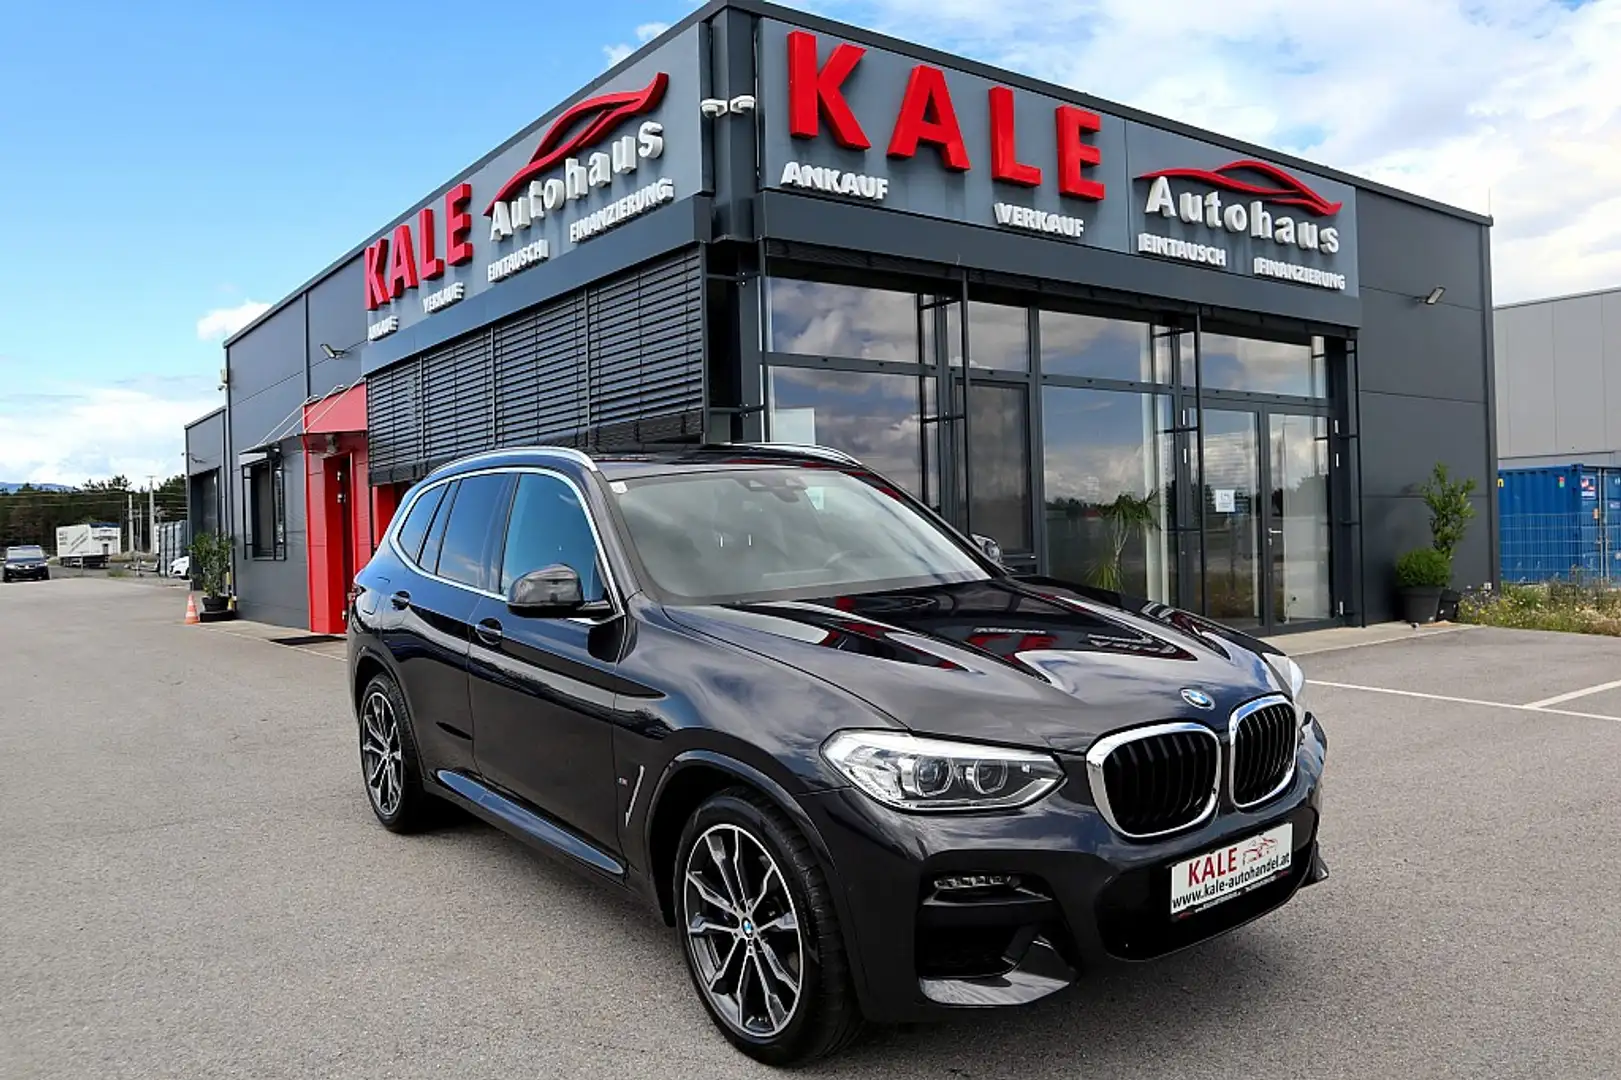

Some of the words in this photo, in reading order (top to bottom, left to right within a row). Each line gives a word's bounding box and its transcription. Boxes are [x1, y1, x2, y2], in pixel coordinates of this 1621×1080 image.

[787, 30, 1105, 200] KALE
[490, 121, 664, 241] Autohaus
[780, 161, 888, 199] ANKAUF
[993, 202, 1084, 238] VERKAUF
[1145, 176, 1339, 253] Autohaus
[364, 183, 473, 311] KALE
[487, 239, 549, 282] EINTAUSCH
[1138, 233, 1226, 267] EINTAUSCH
[1254, 257, 1345, 290] FINANZIERUNG
[1172, 852, 1290, 909] www.kale-autohandel.at
[1188, 848, 1238, 887] KALE
